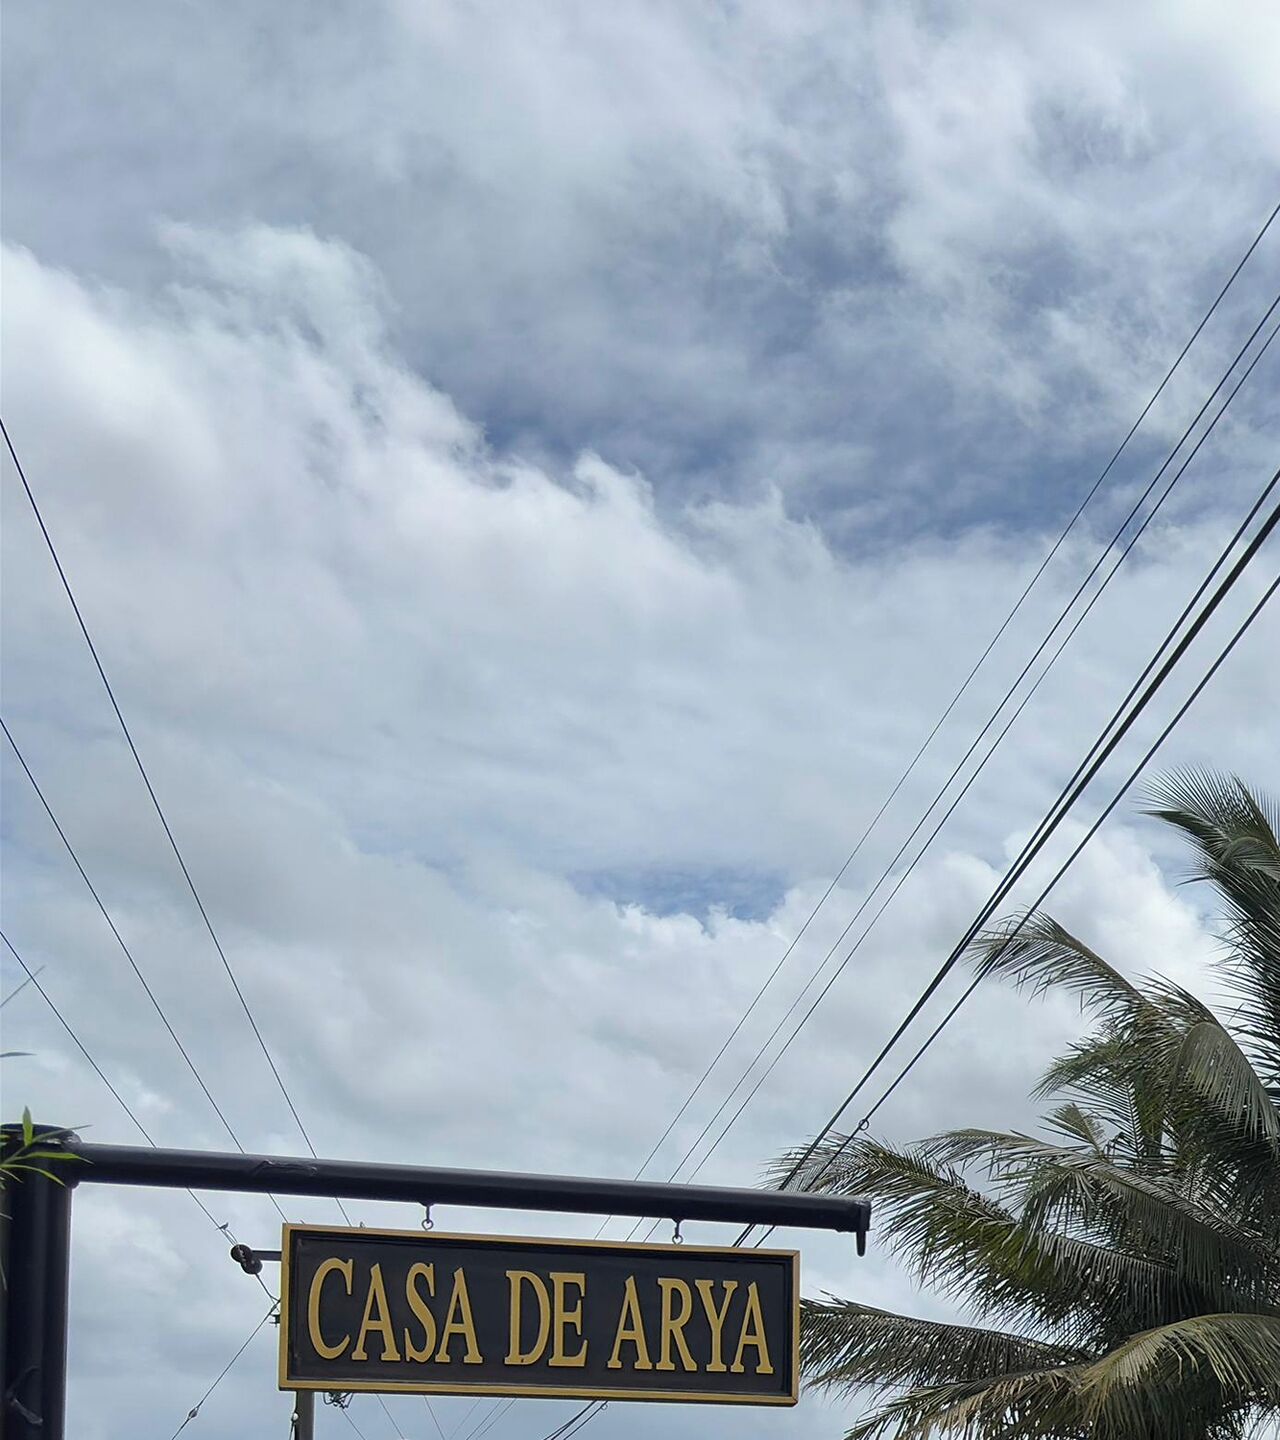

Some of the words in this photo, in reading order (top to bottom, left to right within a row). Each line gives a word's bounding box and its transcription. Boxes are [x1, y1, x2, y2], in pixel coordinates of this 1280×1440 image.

[307, 1257, 484, 1365] CASA
[504, 1270, 588, 1367] DE
[606, 1274, 774, 1375] ARYA
